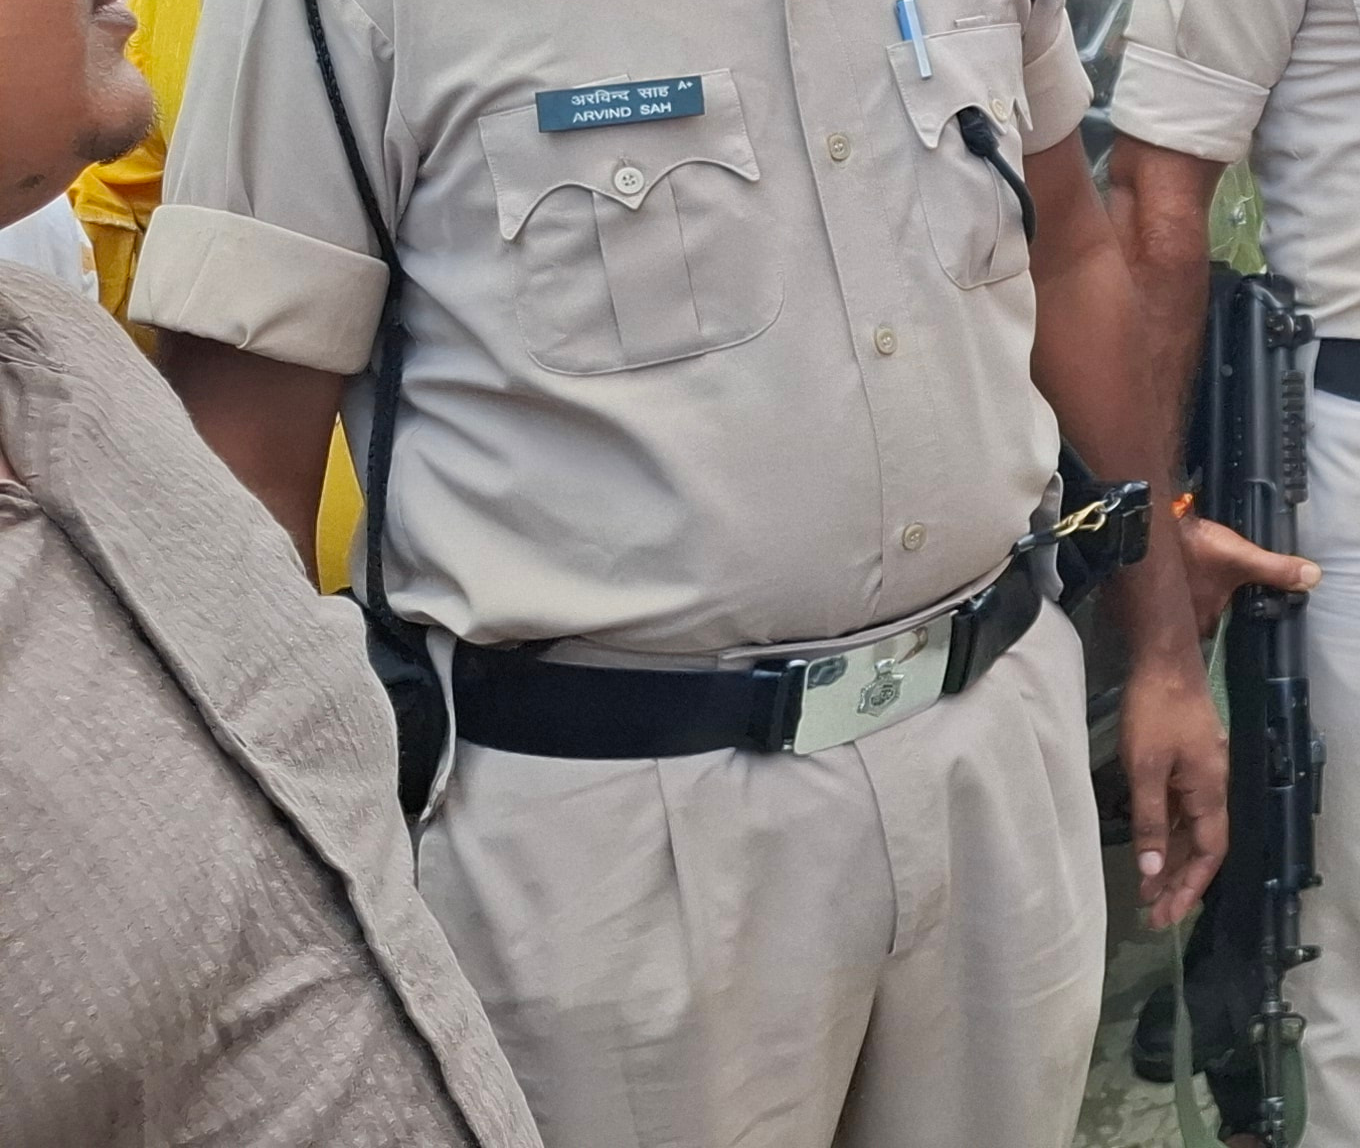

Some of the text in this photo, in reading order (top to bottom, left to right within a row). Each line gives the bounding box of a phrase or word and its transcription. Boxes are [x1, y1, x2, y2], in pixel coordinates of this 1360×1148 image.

[571, 85, 669, 107] अरविन्द साह
[677, 80, 693, 91] A+
[572, 102, 672, 123] ARVIND SAH
